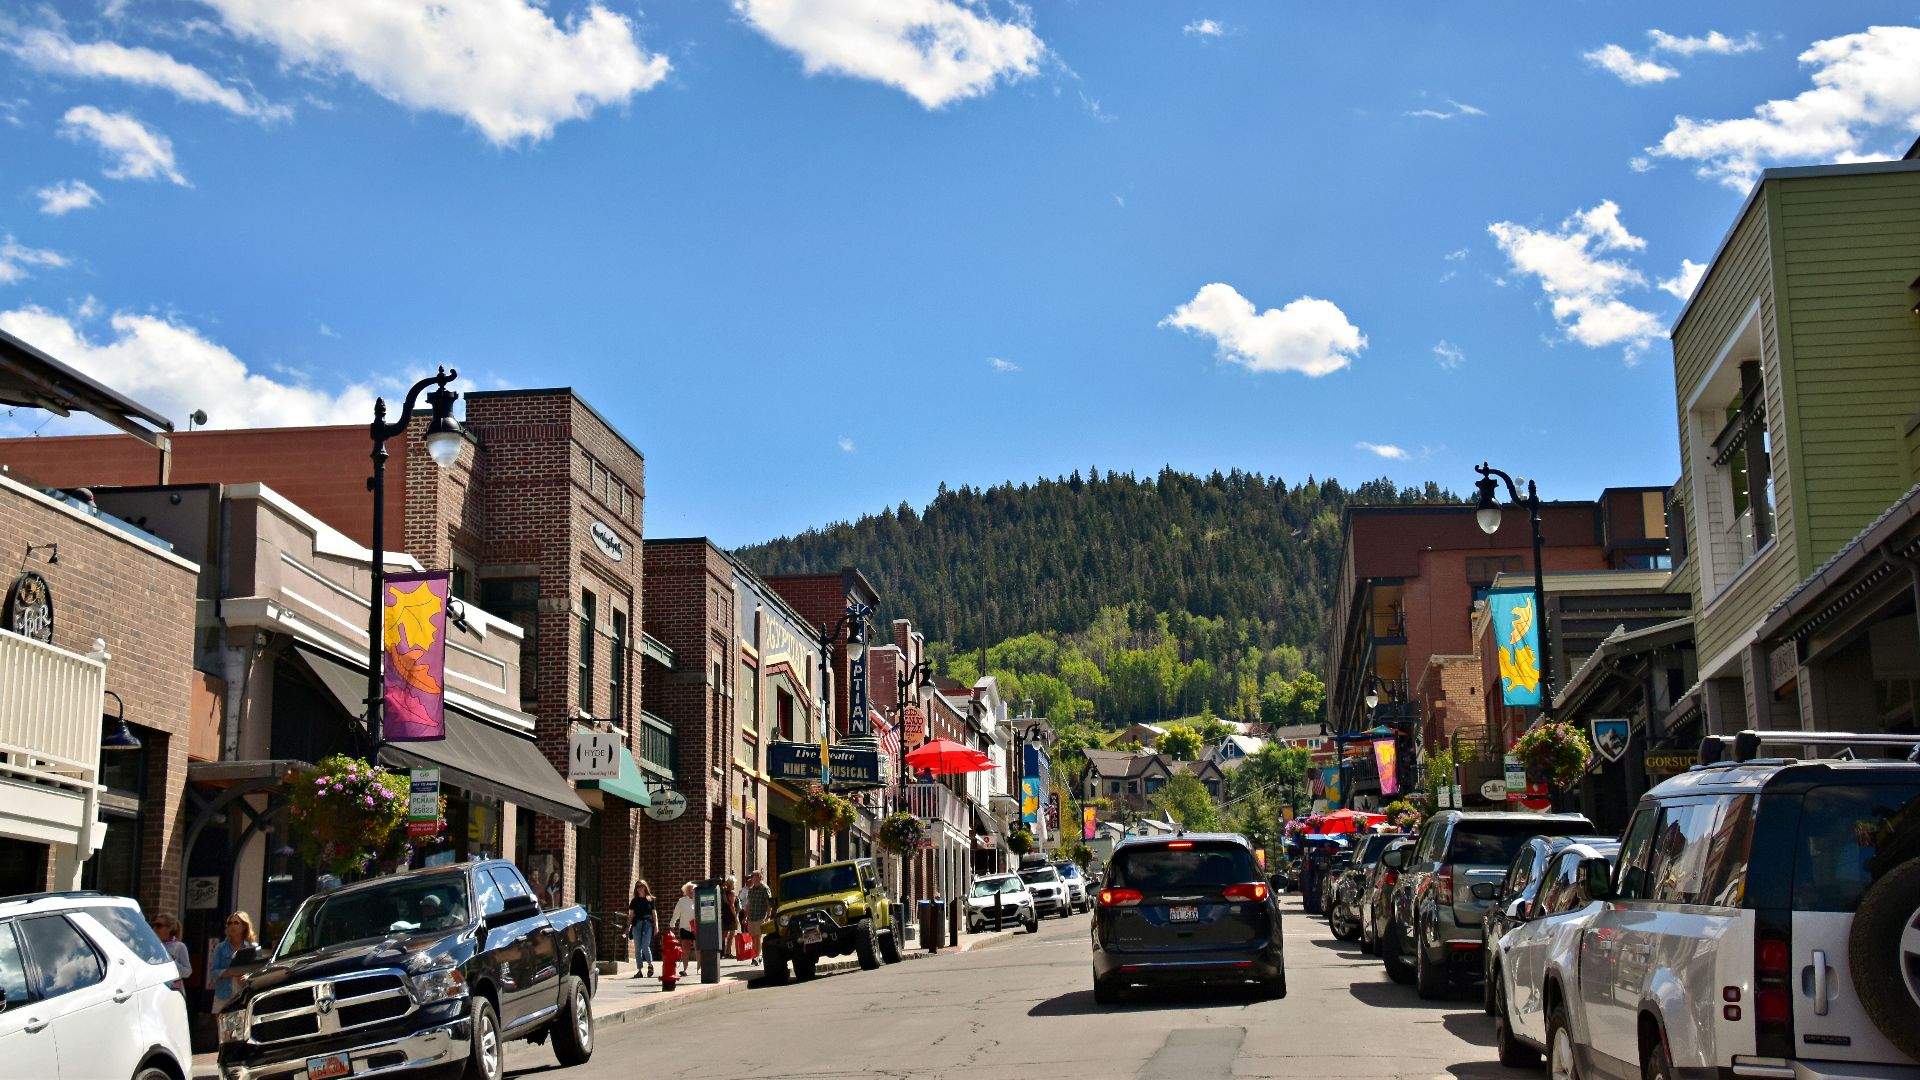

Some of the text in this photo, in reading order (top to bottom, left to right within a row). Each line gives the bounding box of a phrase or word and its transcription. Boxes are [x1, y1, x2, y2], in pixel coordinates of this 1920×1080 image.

[852, 645, 864, 732] PTIAN
[904, 717, 924, 725] ANJO
[904, 725, 922, 733] ZZA
[584, 749, 605, 757] HYDE
[796, 750, 855, 760] Live eatre
[1646, 756, 1699, 767] GORSUC
[783, 762, 807, 775] NINE
